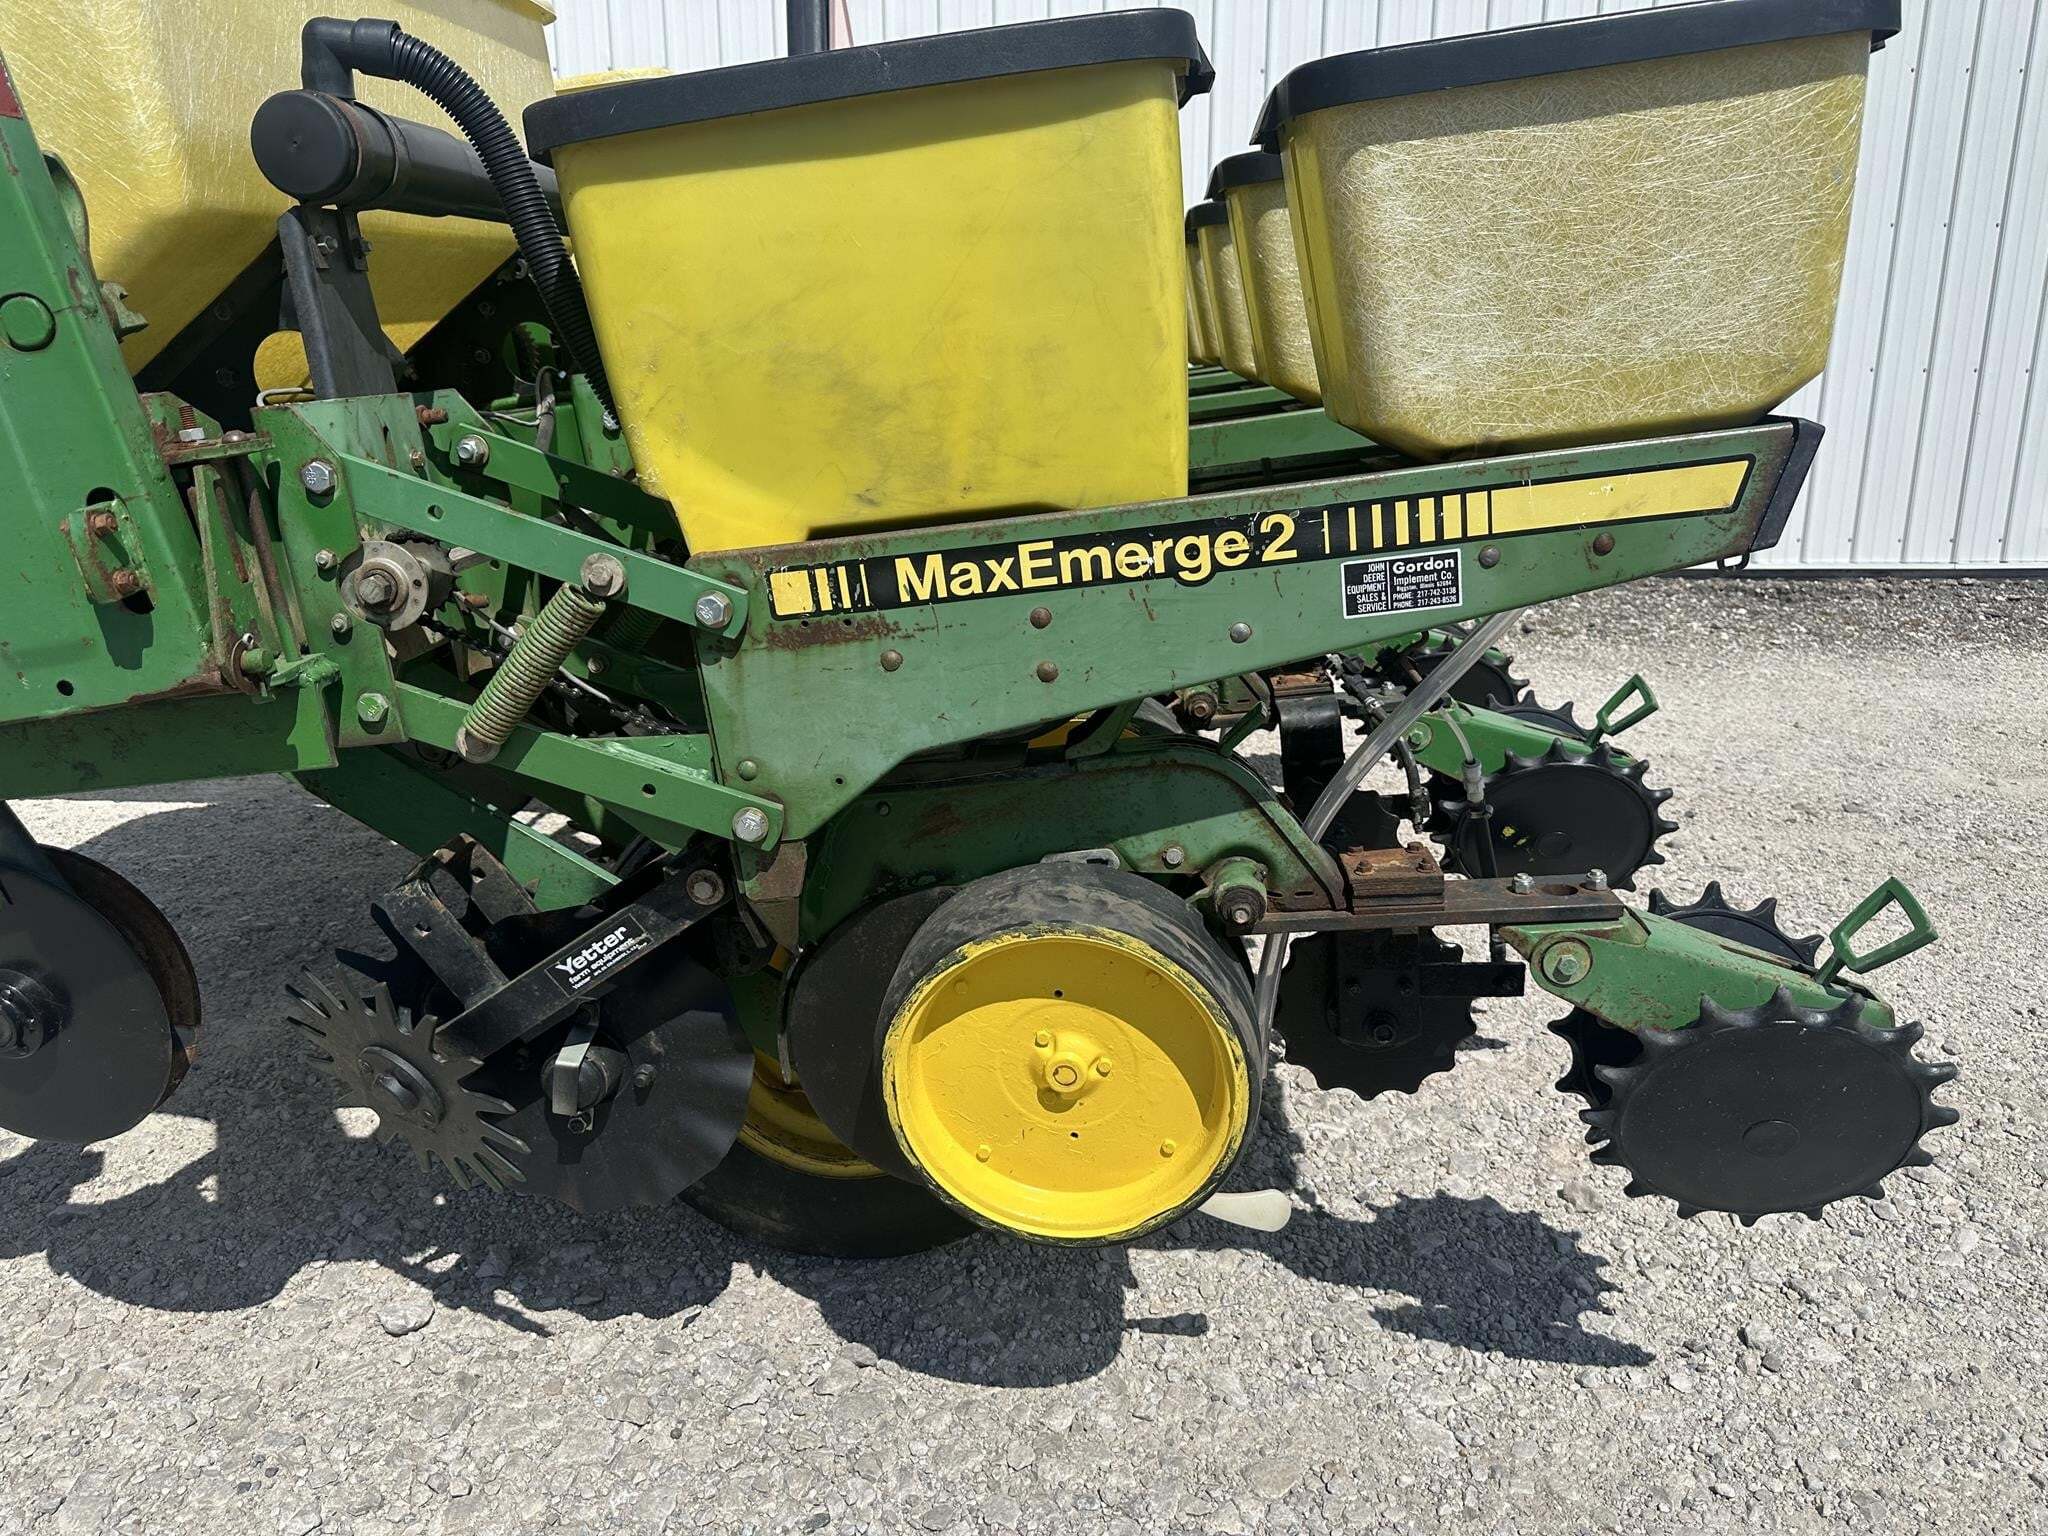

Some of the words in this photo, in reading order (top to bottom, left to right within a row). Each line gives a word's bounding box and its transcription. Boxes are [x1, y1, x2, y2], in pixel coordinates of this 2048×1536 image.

[894, 530, 1250, 603] MaxEmerge
[1260, 513, 1298, 562] 2
[1368, 562, 1385, 573] JOHN
[1392, 556, 1455, 574] Gordon
[1363, 572, 1386, 583] DEERE
[1393, 572, 1438, 586] Implement
[1441, 570, 1455, 580] Co.
[1347, 582, 1386, 595] EQUIPMENT
[1417, 586, 1457, 598] 217-742-3138
[1356, 593, 1379, 604] SALES
[1381, 592, 1387, 601] &
[1358, 602, 1387, 613] SERVICE
[555, 926, 627, 975] Yetter
[568, 968, 591, 984] farm
[590, 937, 635, 970] equipment
